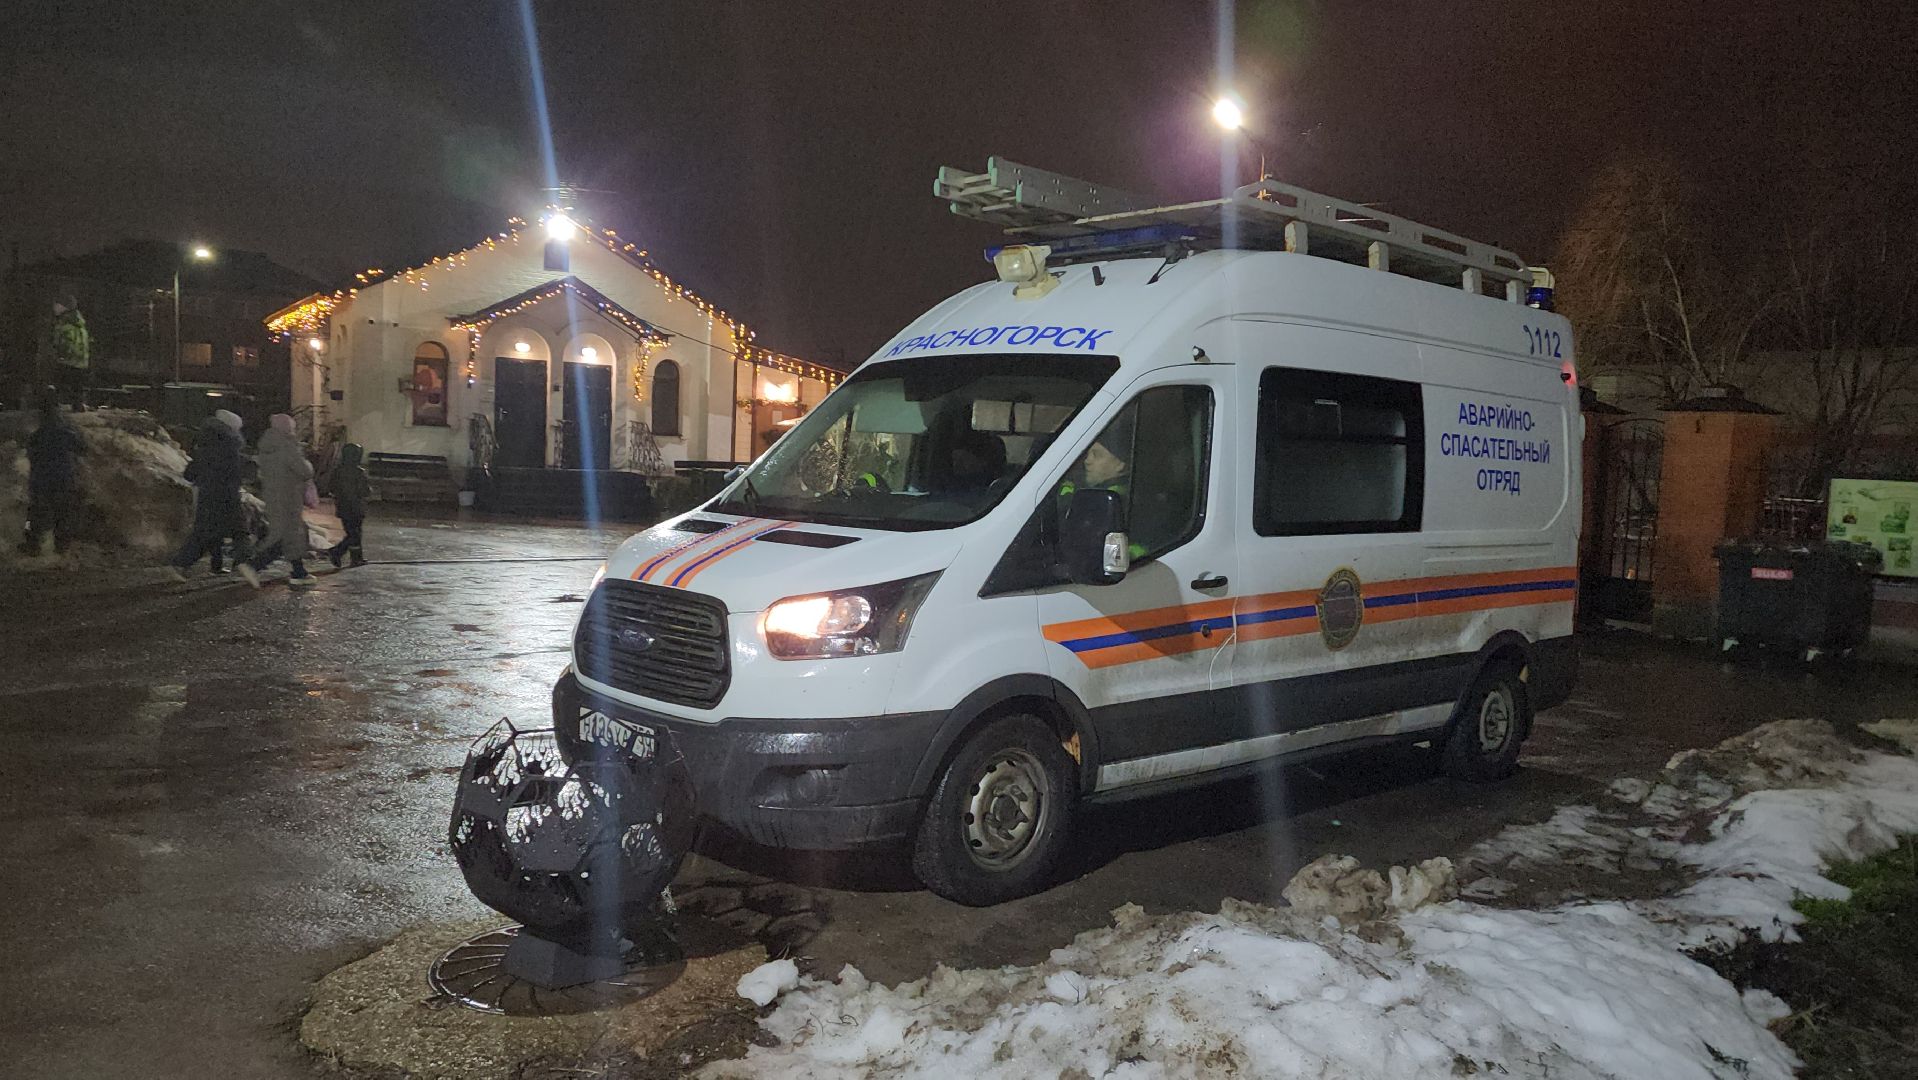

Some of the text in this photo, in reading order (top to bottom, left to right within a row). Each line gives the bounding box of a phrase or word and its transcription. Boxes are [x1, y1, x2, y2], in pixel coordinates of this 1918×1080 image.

[884, 326, 1113, 357] КРАСНОГОРСК
[1535, 327, 1561, 358] 112
[1458, 403, 1535, 431] АВАРИЙНО-
[1441, 433, 1550, 464] СПАСАТЕЛЬНЫЙ
[1477, 469, 1520, 495] ОТРЯД
